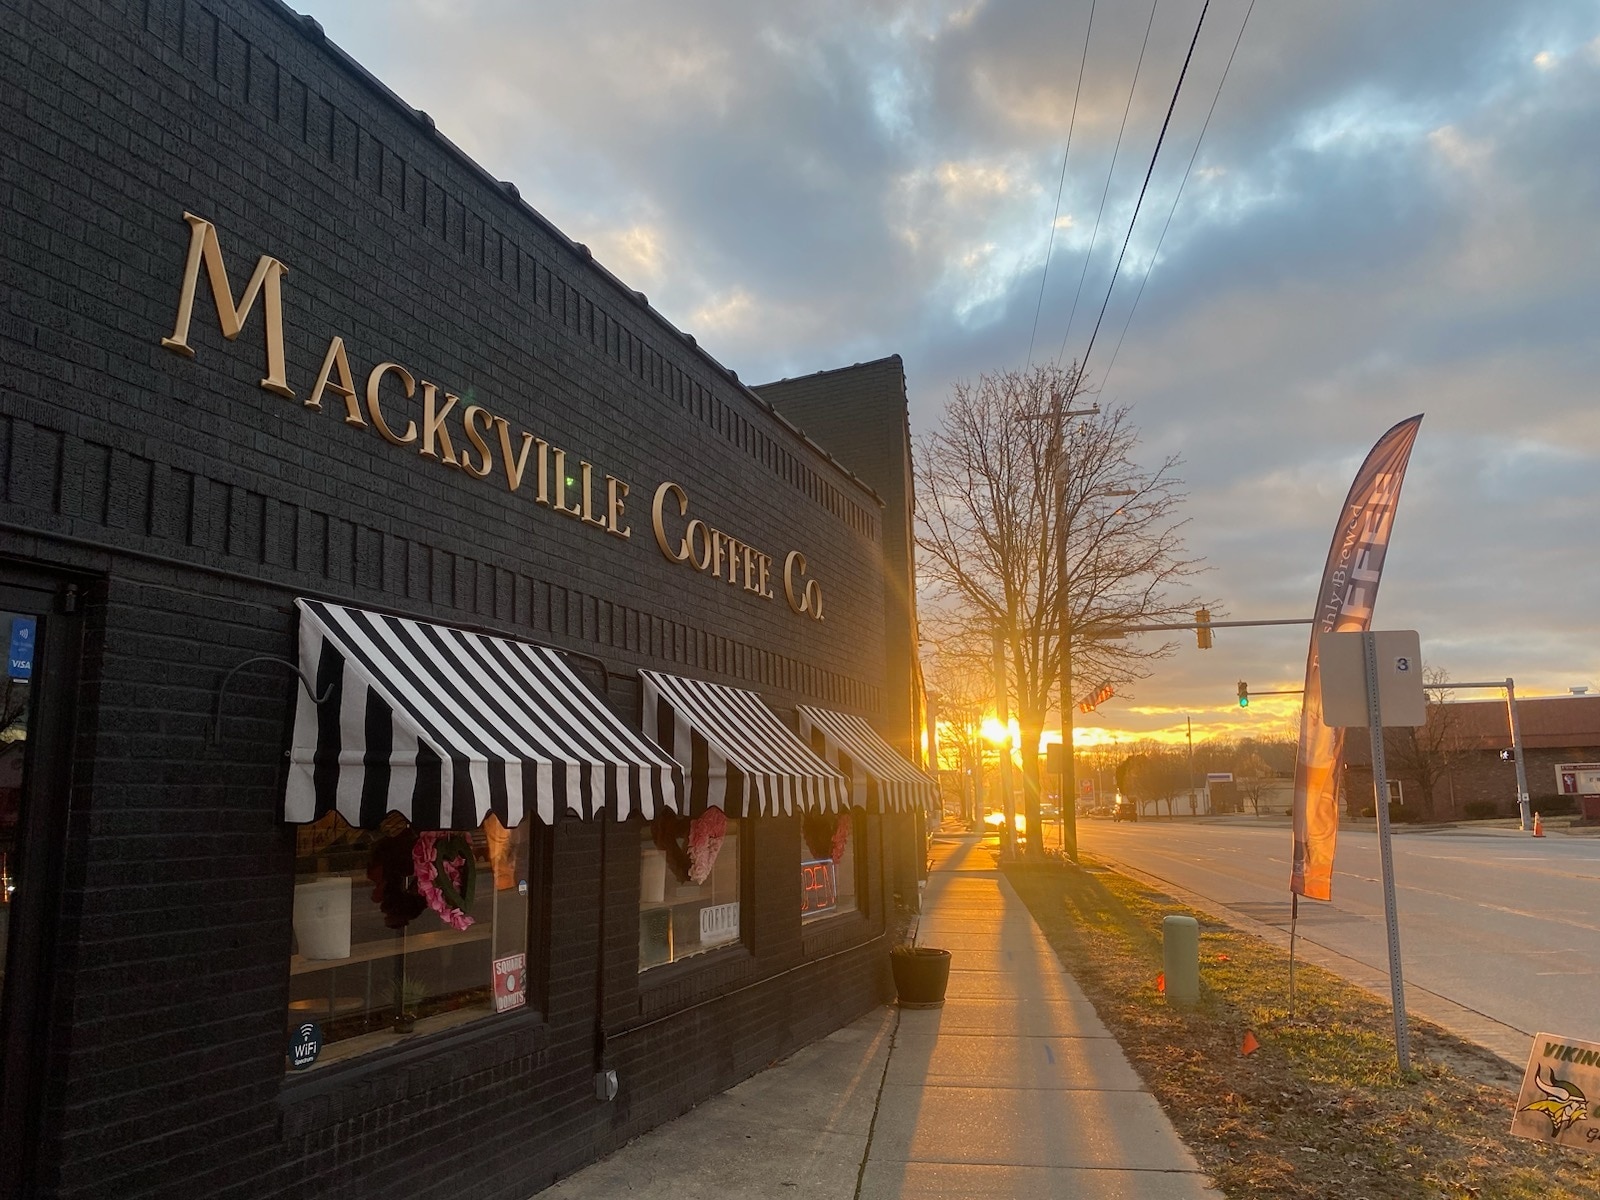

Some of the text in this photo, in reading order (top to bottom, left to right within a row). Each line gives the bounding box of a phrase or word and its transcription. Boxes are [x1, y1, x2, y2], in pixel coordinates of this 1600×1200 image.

[160, 210, 632, 539] MACKSVILLE
[651, 480, 774, 599] COFFEE
[1332, 503, 1364, 587] Brewed
[1337, 472, 1400, 632] FFEE
[11, 659, 31, 670] VISA
[1397, 657, 1409, 671] 3
[801, 865, 835, 910] PEN
[702, 904, 738, 934] COFFEE
[495, 956, 523, 975] SQUARE
[497, 990, 524, 1010] DONUTS
[294, 1040, 317, 1058] WiFi
